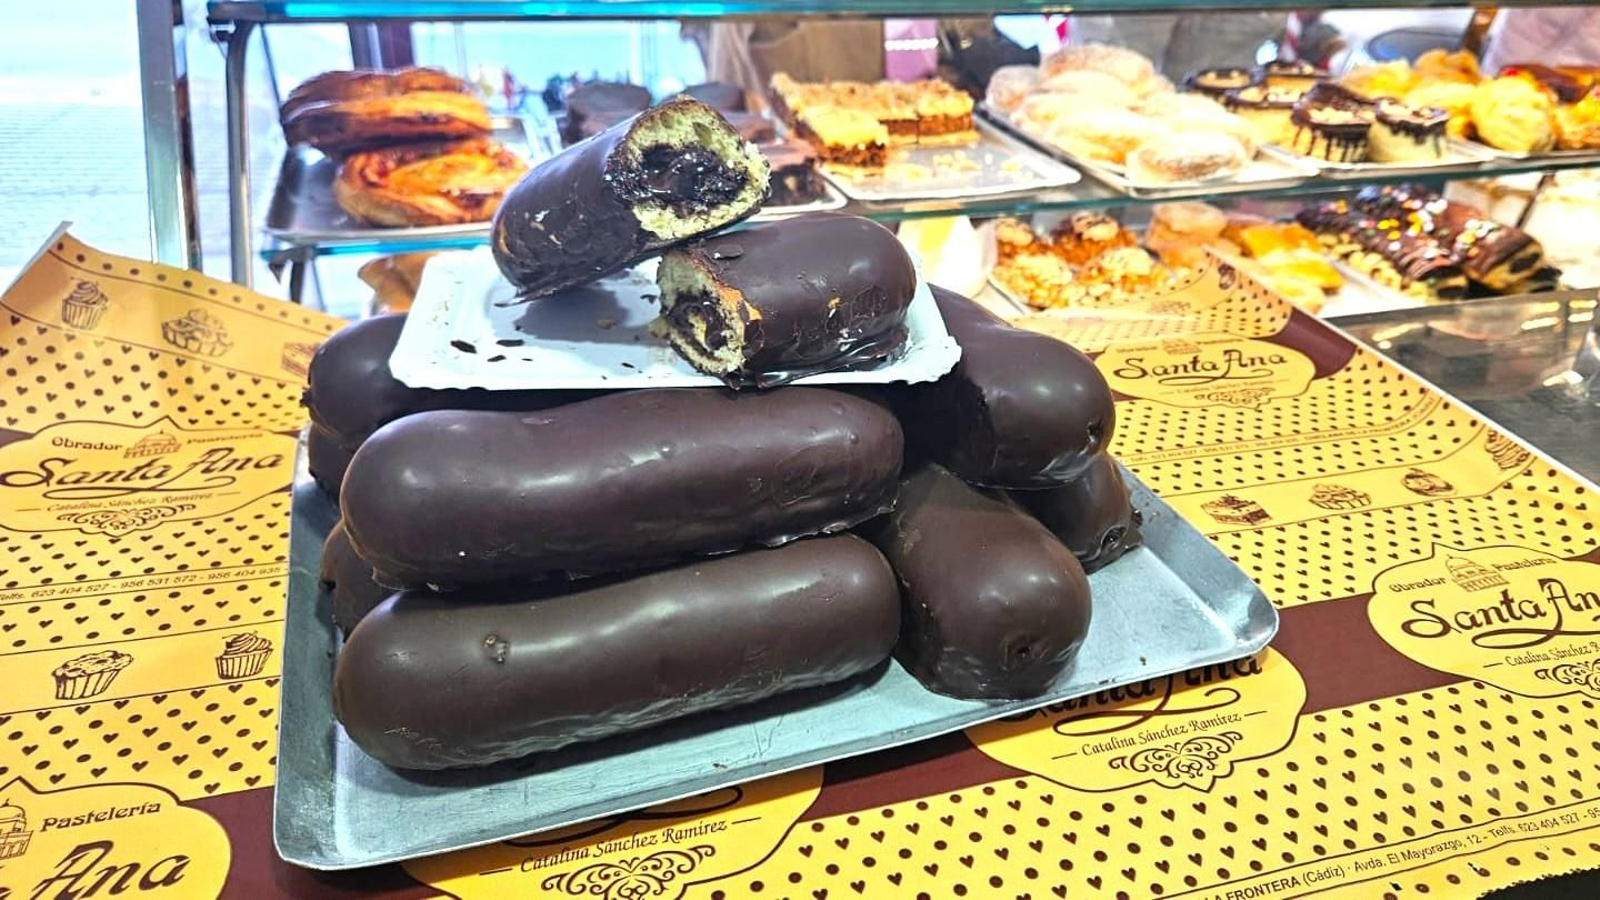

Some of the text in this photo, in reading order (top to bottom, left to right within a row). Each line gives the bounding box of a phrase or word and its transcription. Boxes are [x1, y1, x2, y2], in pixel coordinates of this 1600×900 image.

[1113, 350, 1287, 379] Santa Ana
[52, 436, 122, 451] Obrador
[0, 447, 284, 487] Santa Ana
[31, 589, 55, 598] 623
[58, 587, 82, 595] 404
[85, 583, 109, 592] 527
[120, 580, 144, 588] 956
[147, 577, 170, 586] 531
[173, 575, 197, 583] 572
[234, 569, 256, 577] 404
[1389, 576, 1446, 592] Obrador
[1401, 578, 1600, 638] Santa An
[1505, 651, 1551, 666] Catalina
[1081, 712, 1242, 756] Catalina Sánchez Ramírez
[40, 802, 161, 832] Pastelería
[521, 818, 727, 872] Catalina Sánchez Ramírez
[1226, 876, 1301, 900] FRONTERA
[1303, 865, 1345, 886] (Cádiz)
[1354, 855, 1387, 872] Avda.
[1388, 851, 1400, 865] El
[1467, 834, 1482, 846] 12
[1518, 821, 1539, 832] 623
[1540, 818, 1559, 829] 404
[1560, 812, 1580, 824] 527
[1587, 807, 1600, 819] 95
[31, 840, 191, 900] Ana
